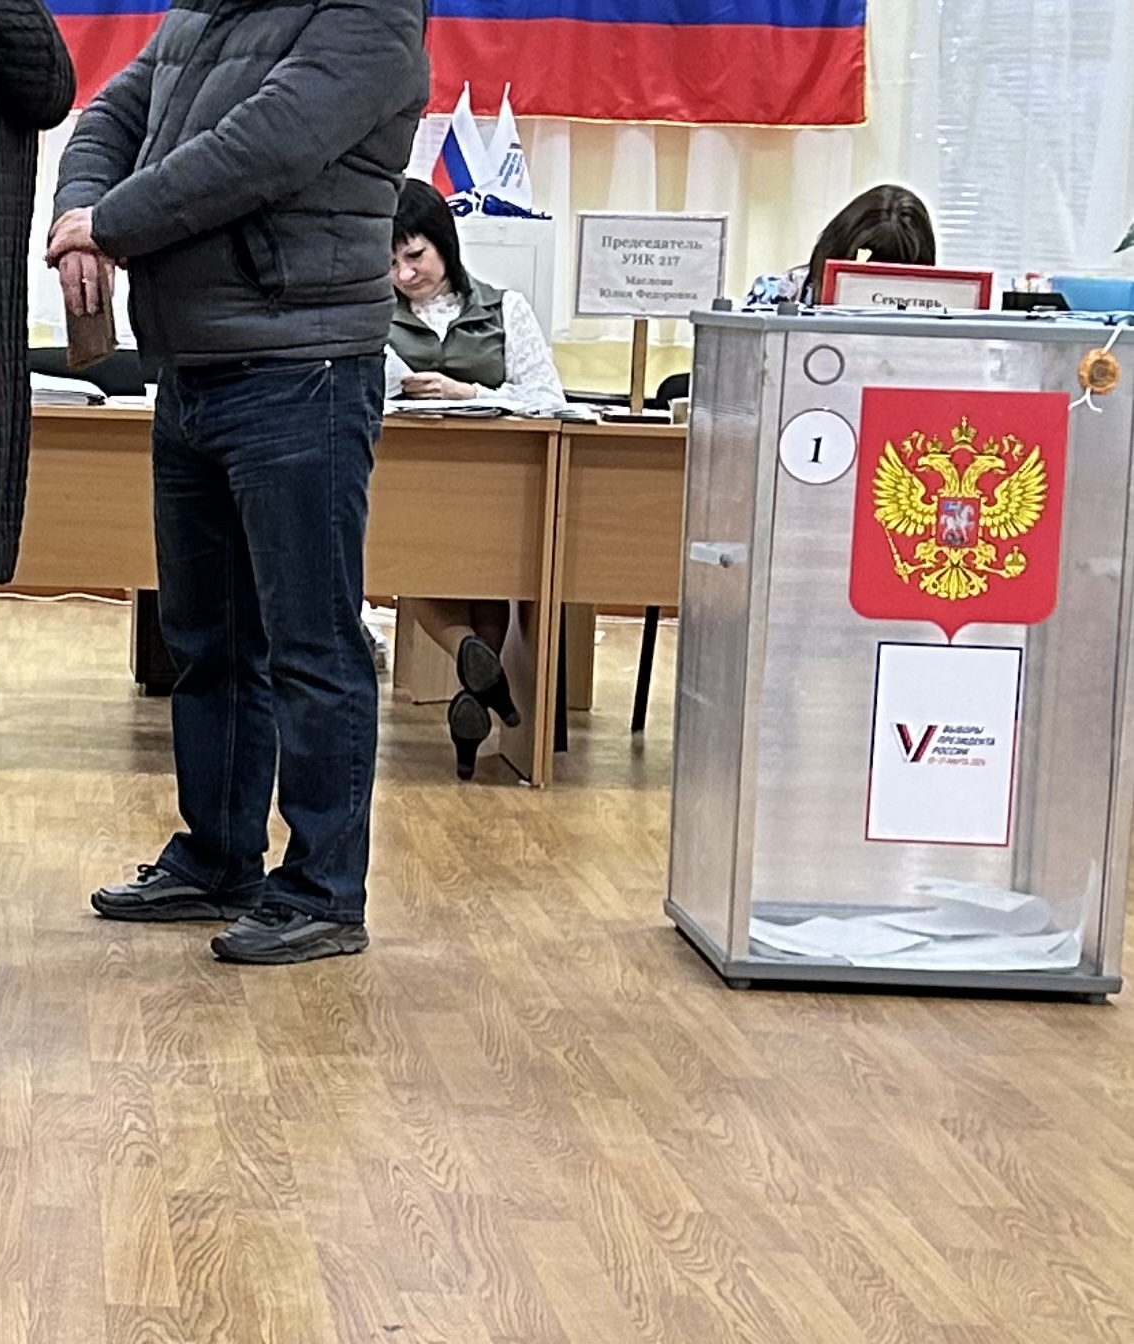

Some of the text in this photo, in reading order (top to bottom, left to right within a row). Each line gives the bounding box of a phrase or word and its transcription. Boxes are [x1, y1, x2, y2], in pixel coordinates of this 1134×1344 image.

[601, 235, 703, 250] Председатель
[621, 253, 681, 267] УИК 217
[808, 436, 823, 464] 1
